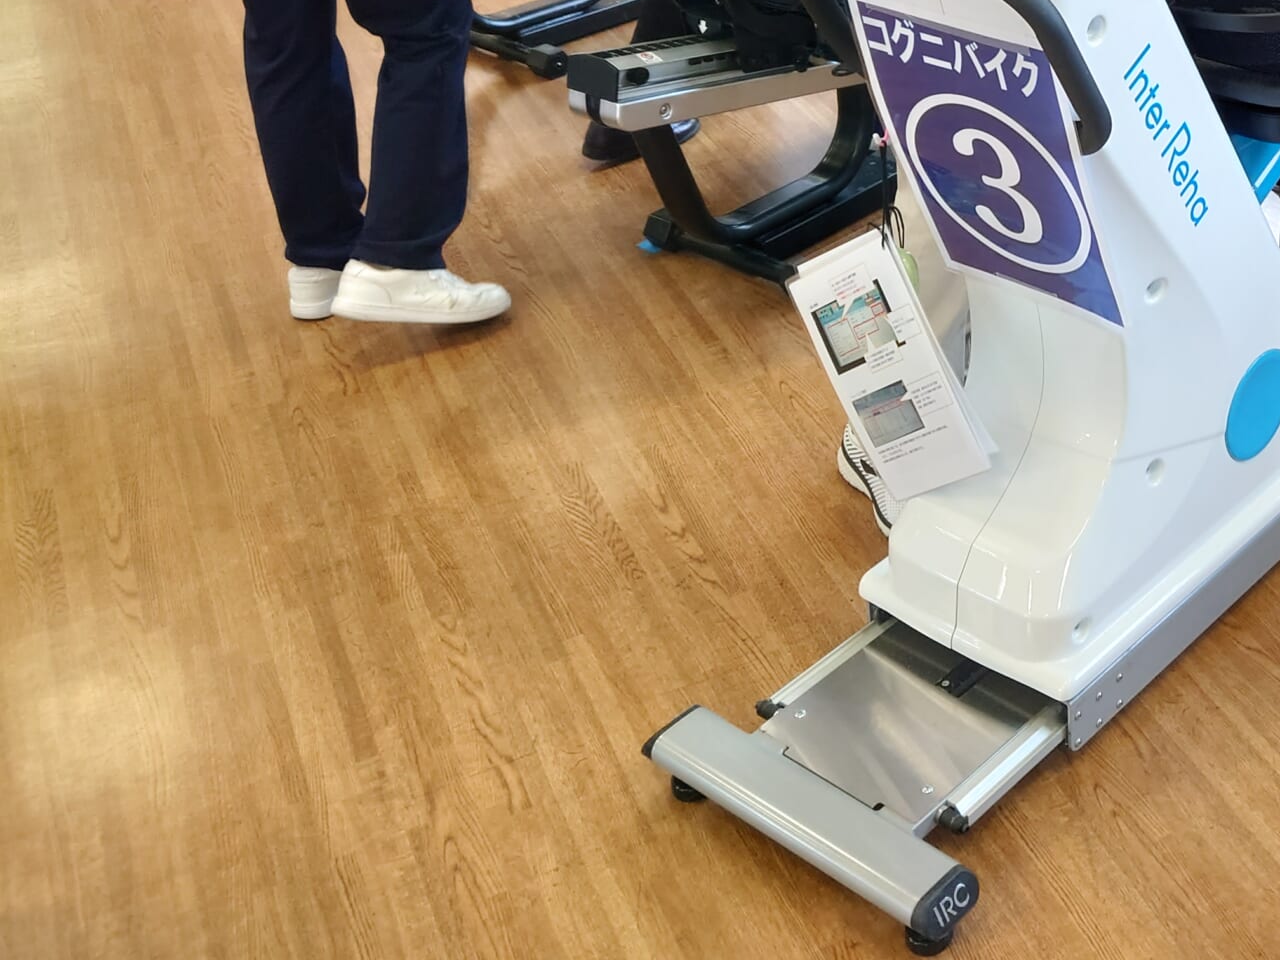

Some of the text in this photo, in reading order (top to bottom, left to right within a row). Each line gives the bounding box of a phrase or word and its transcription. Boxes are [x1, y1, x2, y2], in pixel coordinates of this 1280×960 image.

[862, 15, 1039, 98] コグニバイク
[932, 882, 970, 928] IRC
